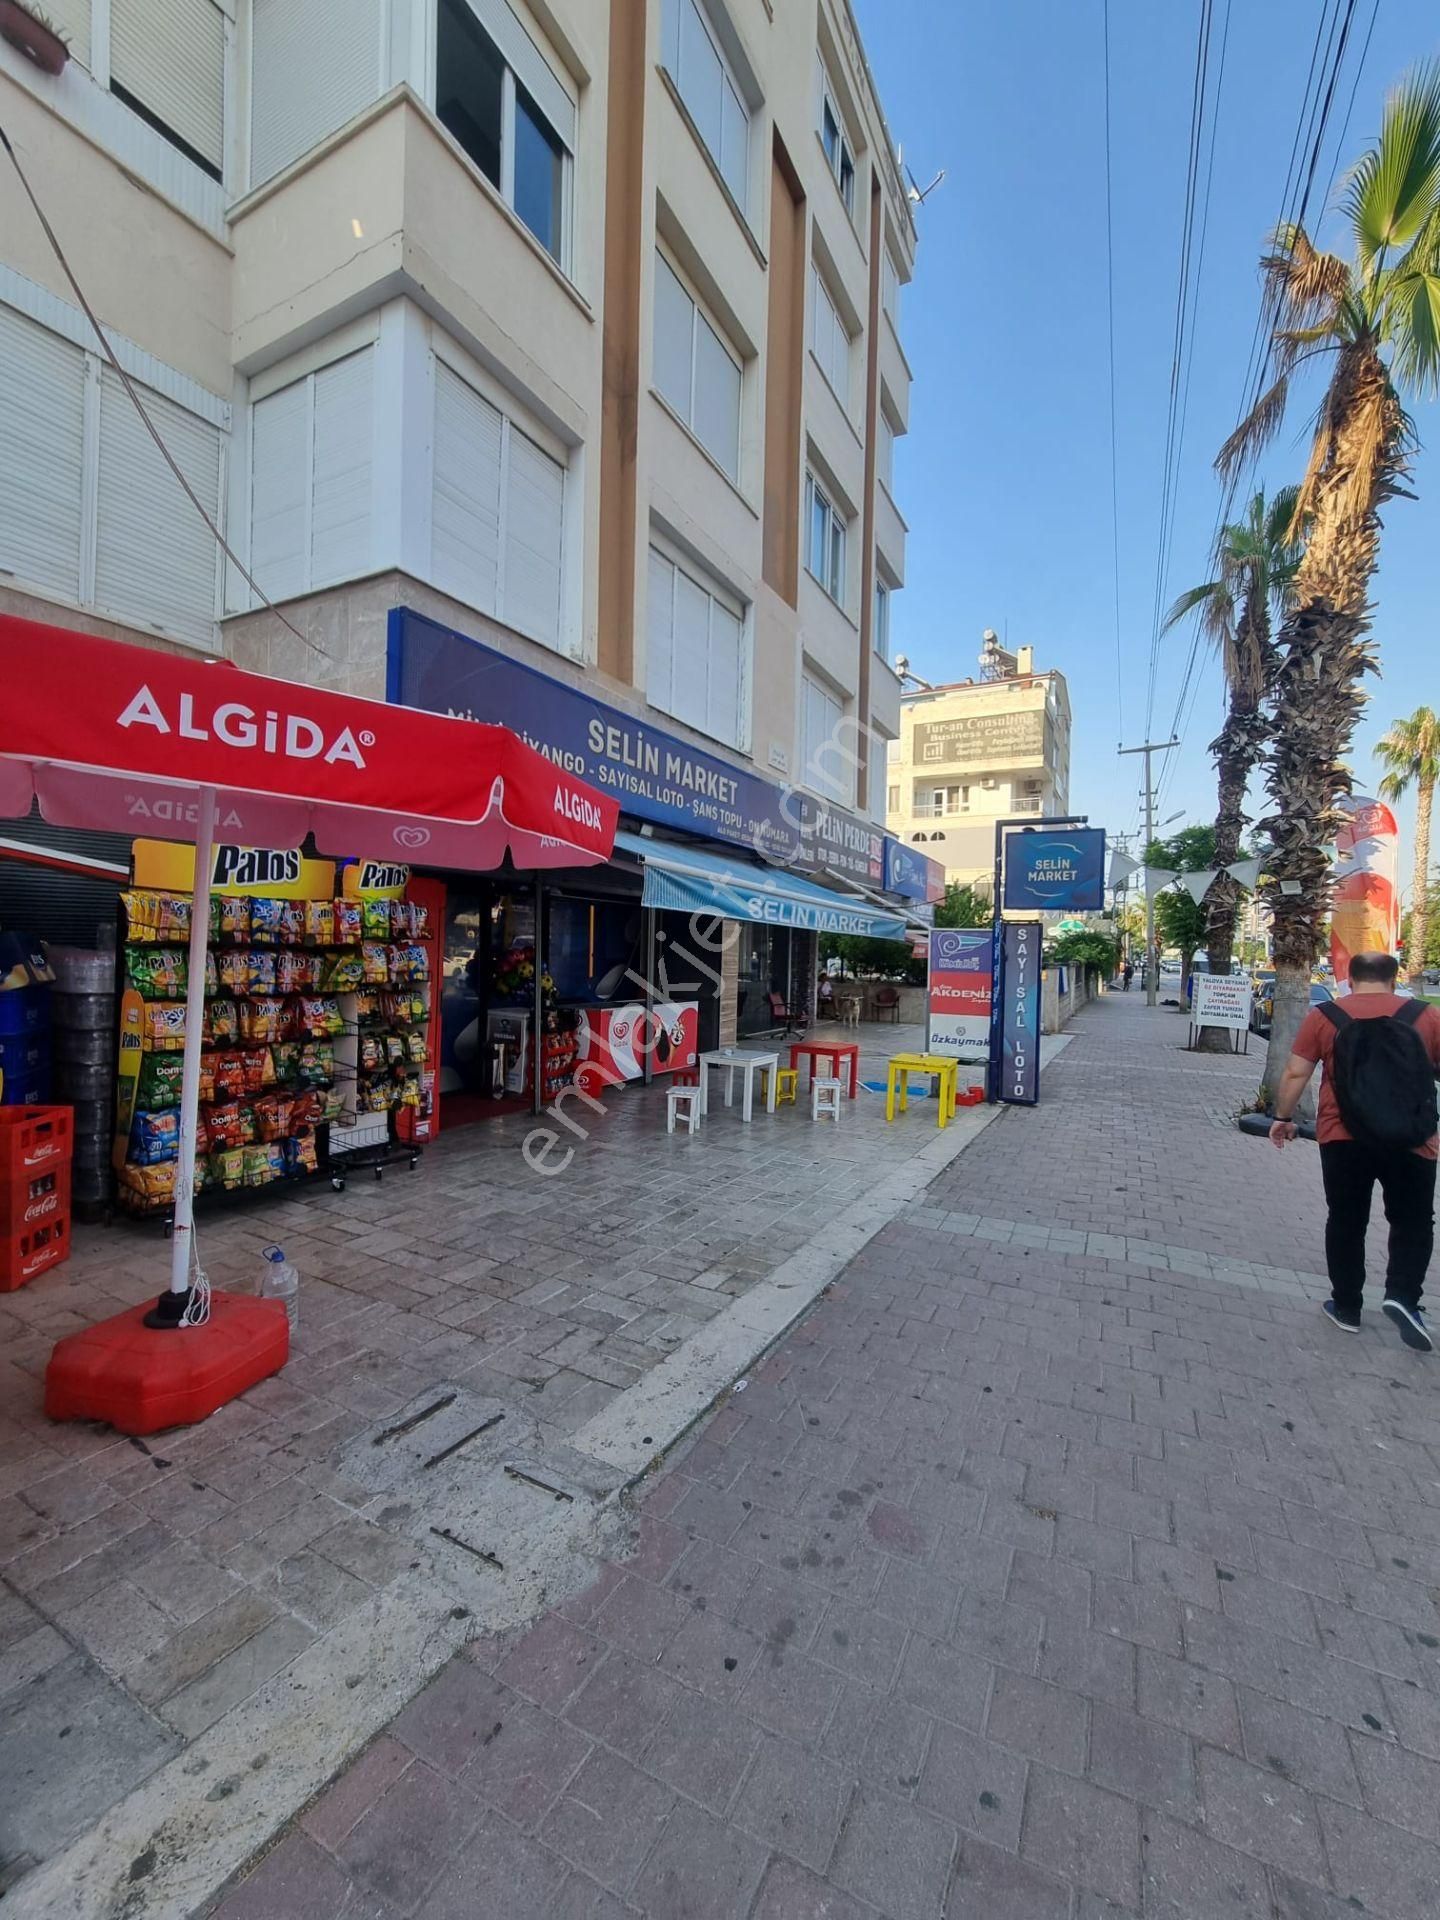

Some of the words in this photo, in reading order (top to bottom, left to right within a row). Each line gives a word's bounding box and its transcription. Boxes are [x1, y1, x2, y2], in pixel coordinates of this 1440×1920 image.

[599, 766, 653, 798] SAYISAL
[656, 785, 684, 809] LOTO
[693, 801, 718, 821] ŞANS
[720, 808, 742, 828] TOPU
[665, 752, 738, 805] MARKET
[844, 823, 870, 855] PERDE
[1028, 870, 1077, 882] MARKET
[814, 910, 874, 935] MARKET
[1015, 928, 1028, 1028] SAYISAL
[1013, 1041, 1026, 1097] LOTO
